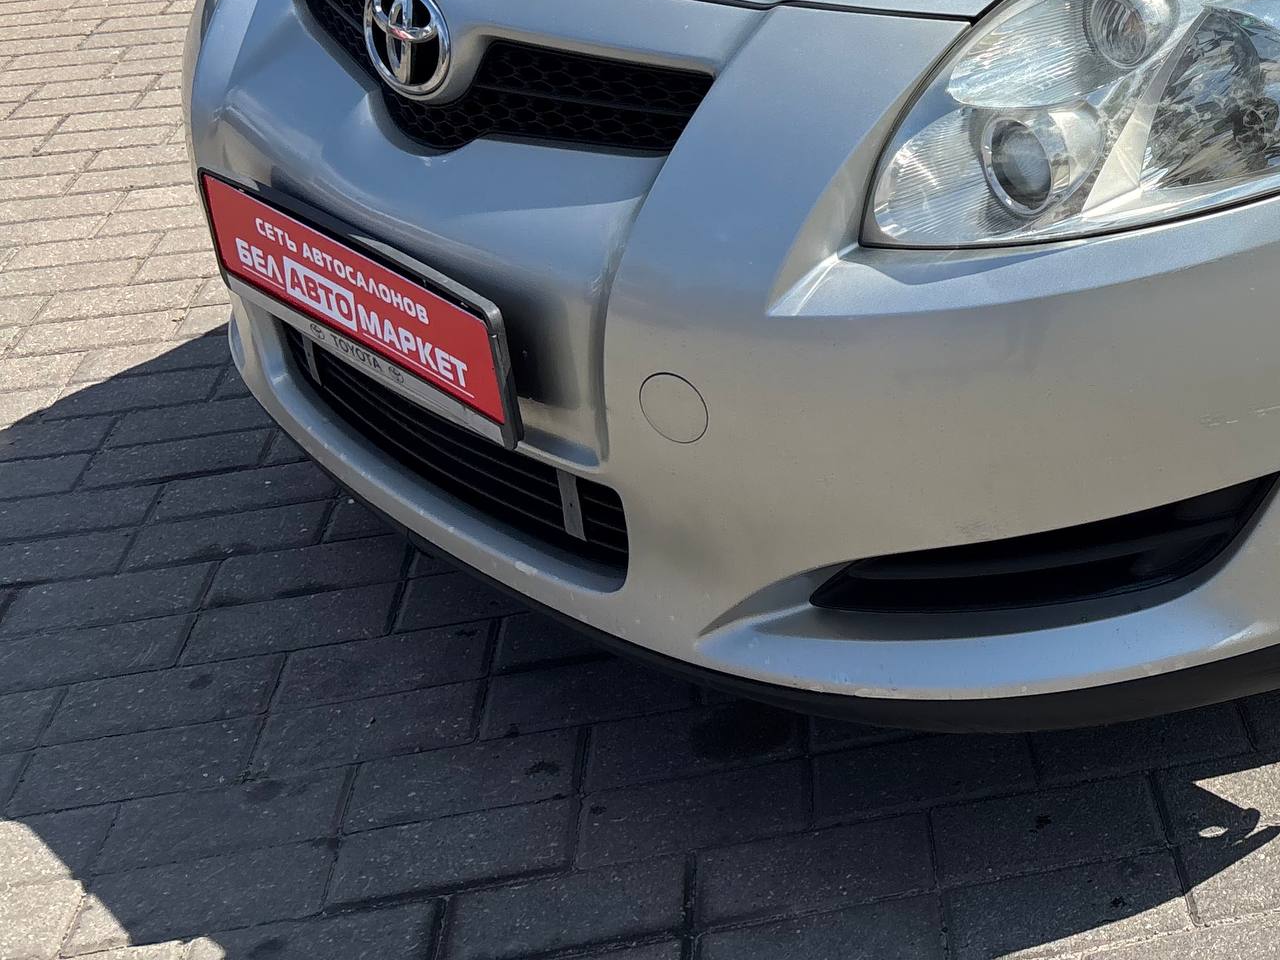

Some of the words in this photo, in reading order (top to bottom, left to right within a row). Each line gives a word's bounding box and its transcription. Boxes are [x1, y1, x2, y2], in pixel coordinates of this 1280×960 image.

[255, 217, 297, 253] СЕТЬ
[302, 242, 429, 325] АВТОСАЛОНОВ
[330, 332, 384, 373] TOYOTA
